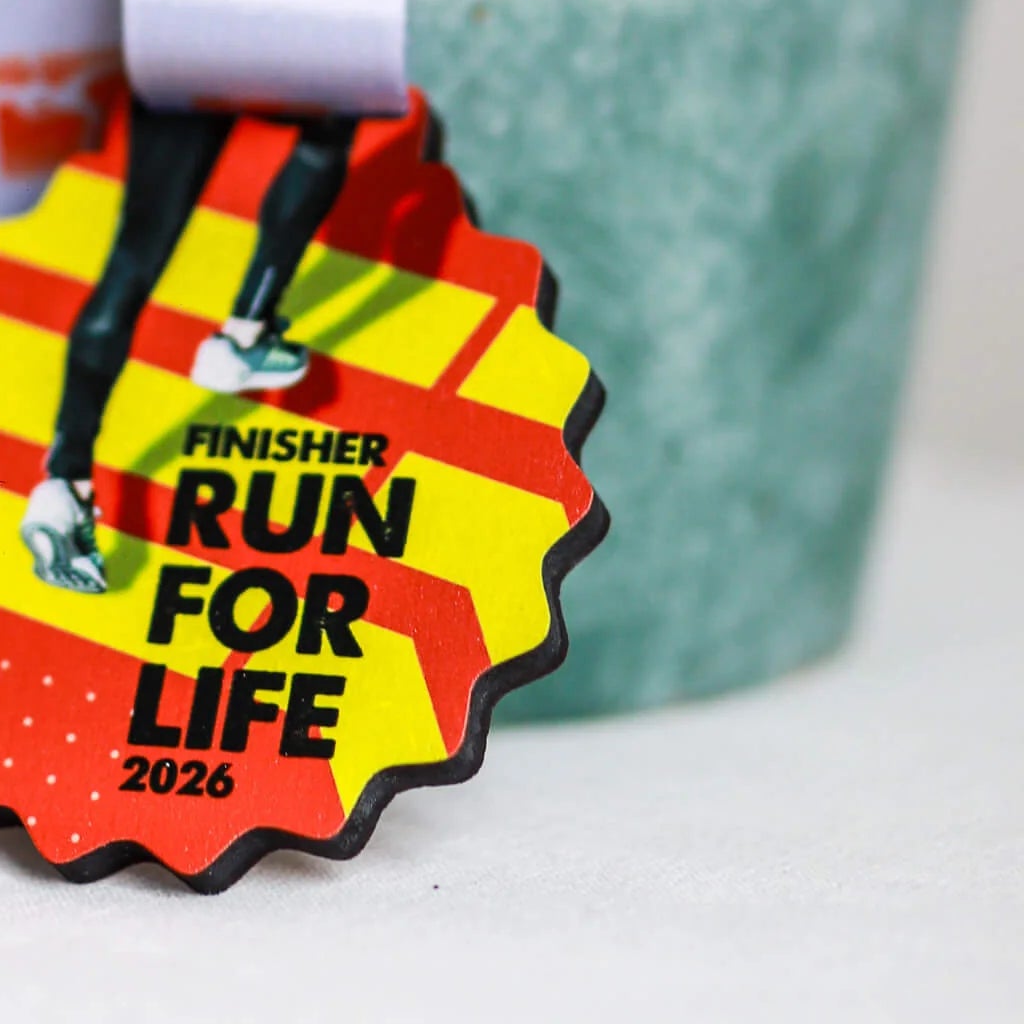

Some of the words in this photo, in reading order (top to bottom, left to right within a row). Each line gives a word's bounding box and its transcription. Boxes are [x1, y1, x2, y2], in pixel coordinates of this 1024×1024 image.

[182, 424, 389, 467] FINISHER
[166, 468, 416, 558] RUN
[146, 564, 370, 658] FOR
[127, 663, 346, 759] LIFE
[118, 756, 235, 798] 2026
